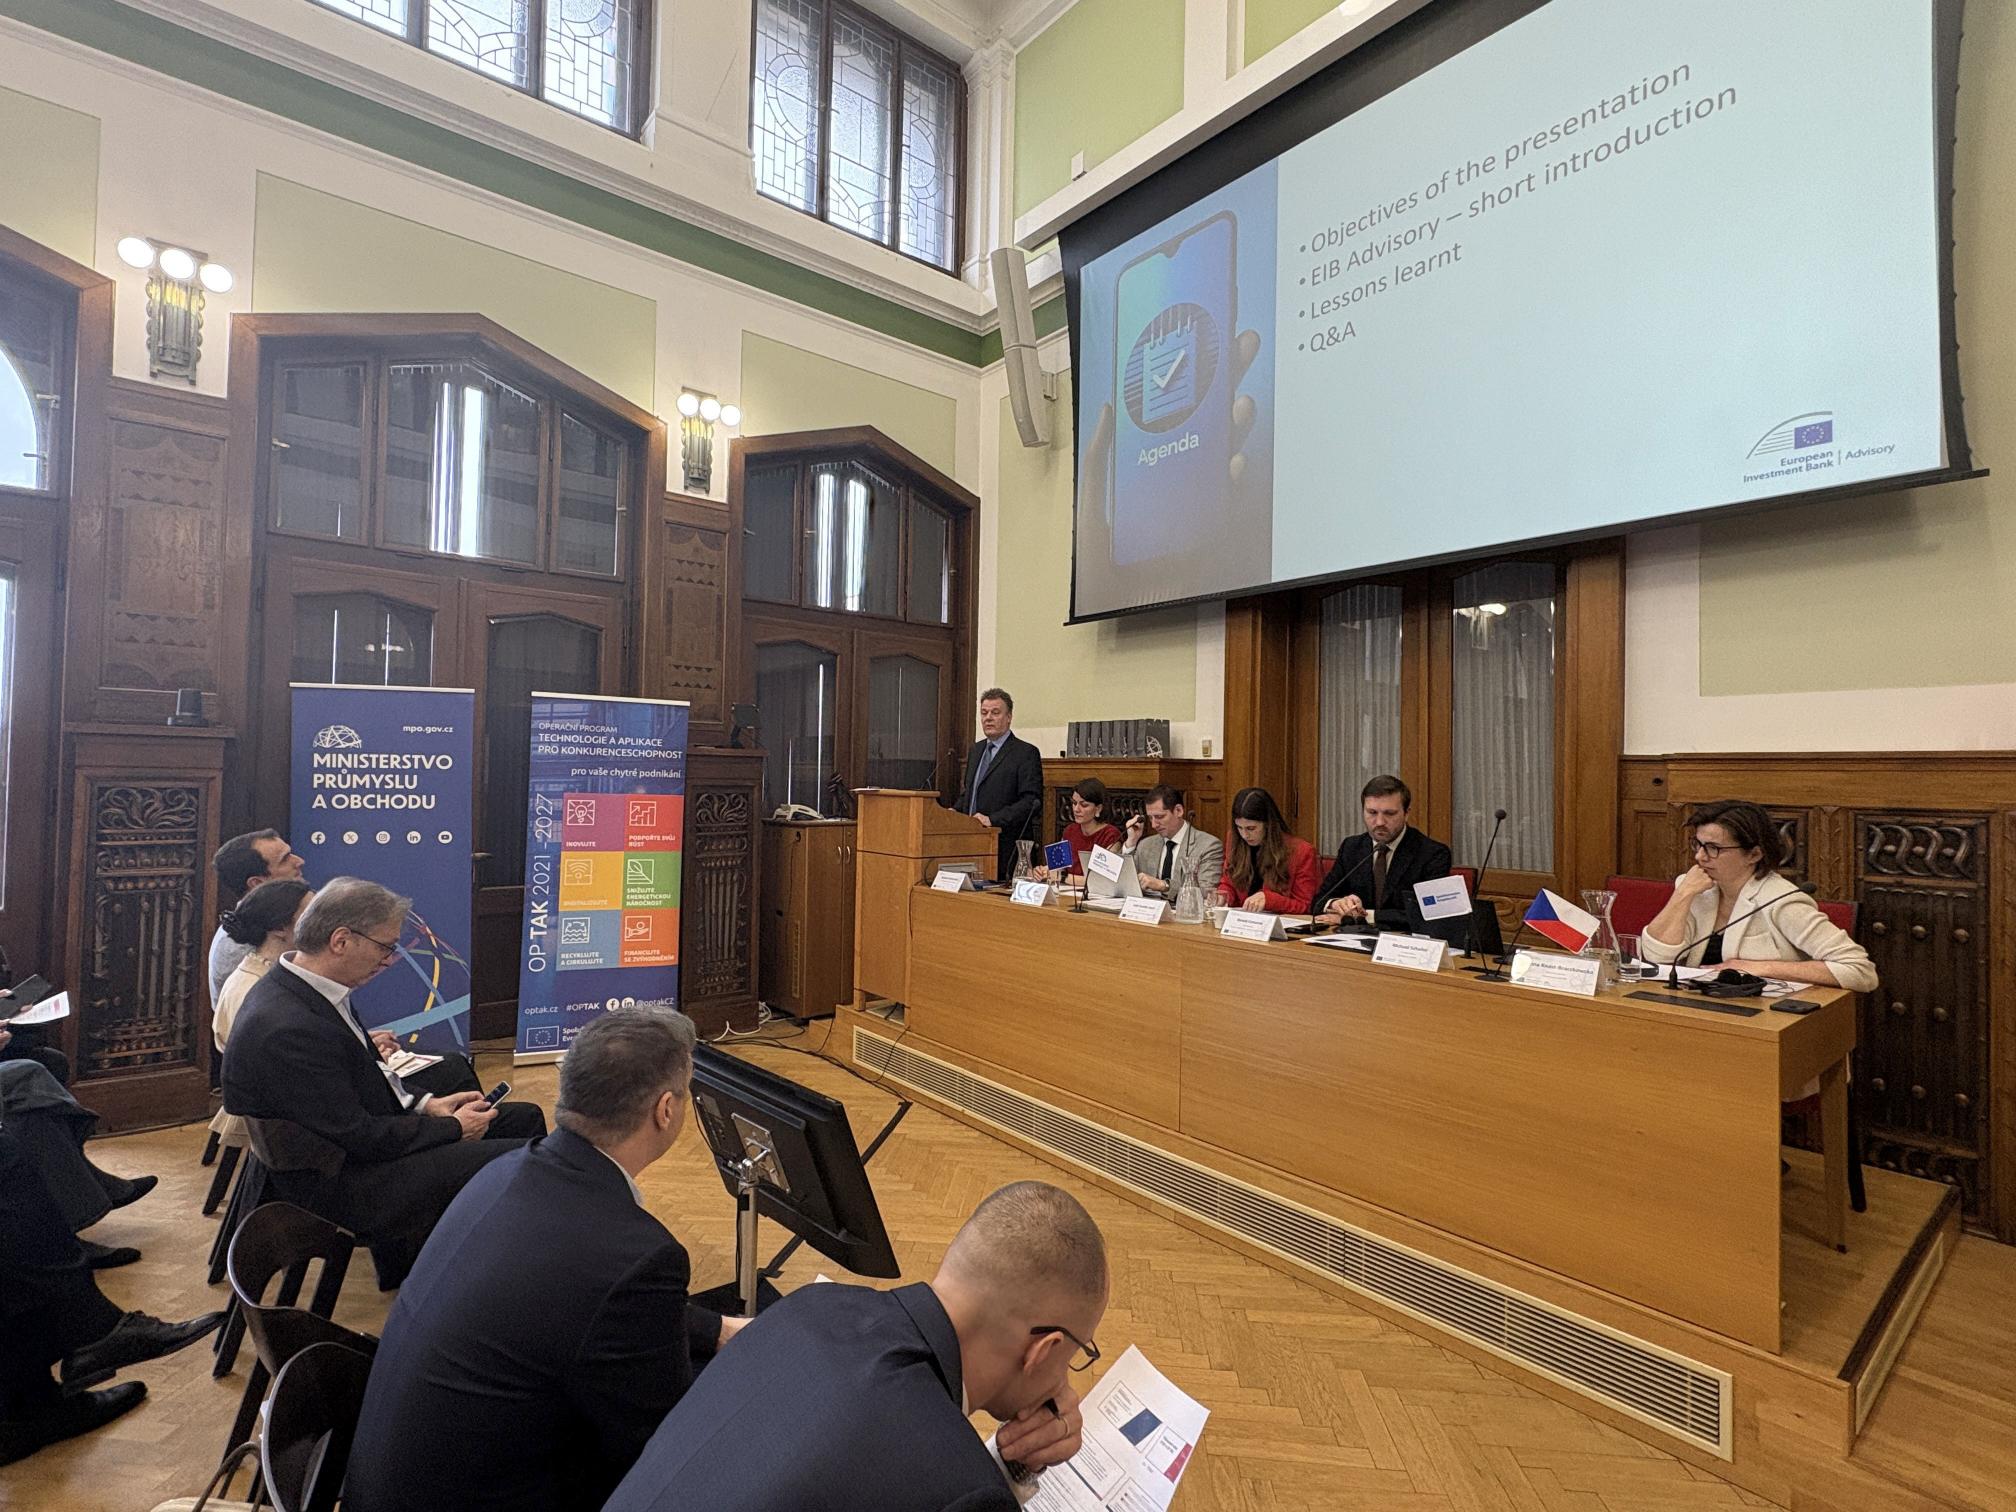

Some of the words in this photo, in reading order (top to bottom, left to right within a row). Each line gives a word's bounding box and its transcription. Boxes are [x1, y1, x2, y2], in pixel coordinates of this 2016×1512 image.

[1311, 191, 1419, 253] Objectives
[1425, 173, 1450, 200] of
[1455, 154, 1496, 186] the
[1504, 63, 1691, 169] presentation
[1311, 260, 1341, 287] EIB
[1346, 217, 1440, 272] Advisory
[1468, 173, 1536, 218] short
[1544, 86, 1737, 186] introduction
[1311, 276, 1388, 320] Lessons
[1394, 242, 1463, 285] learnt
[1310, 321, 1357, 354] Q&A
[1138, 432, 1200, 466] Agenda
[1780, 451, 1833, 467] European
[1845, 444, 1895, 460] Advisory
[1743, 466, 1803, 483] Investment
[1805, 460, 1834, 472] Bank
[403, 725, 454, 734] mpo.gov.cz
[538, 734, 607, 745] TECHNOLOGIE
[609, 737, 616, 745] A
[618, 738, 663, 747] APLIKACE
[579, 725, 618, 733] PROGRAM
[313, 753, 453, 770] MINISTERSTVO
[538, 745, 559, 754] PRO
[561, 747, 683, 759] KONKURENCESCHOPNOST
[313, 768, 418, 790] PRŮMYSLU
[588, 767, 608, 776] vaše
[610, 768, 638, 778] chytré
[639, 769, 681, 779] podnikání
[312, 794, 327, 809] A
[331, 794, 436, 809] OBCHODU
[535, 793, 553, 840] 2027
[530, 900, 549, 940] TAK
[529, 944, 546, 973] OP
[524, 1006, 558, 1016] optak.cz
[566, 1002, 600, 1012] #OPTAK
